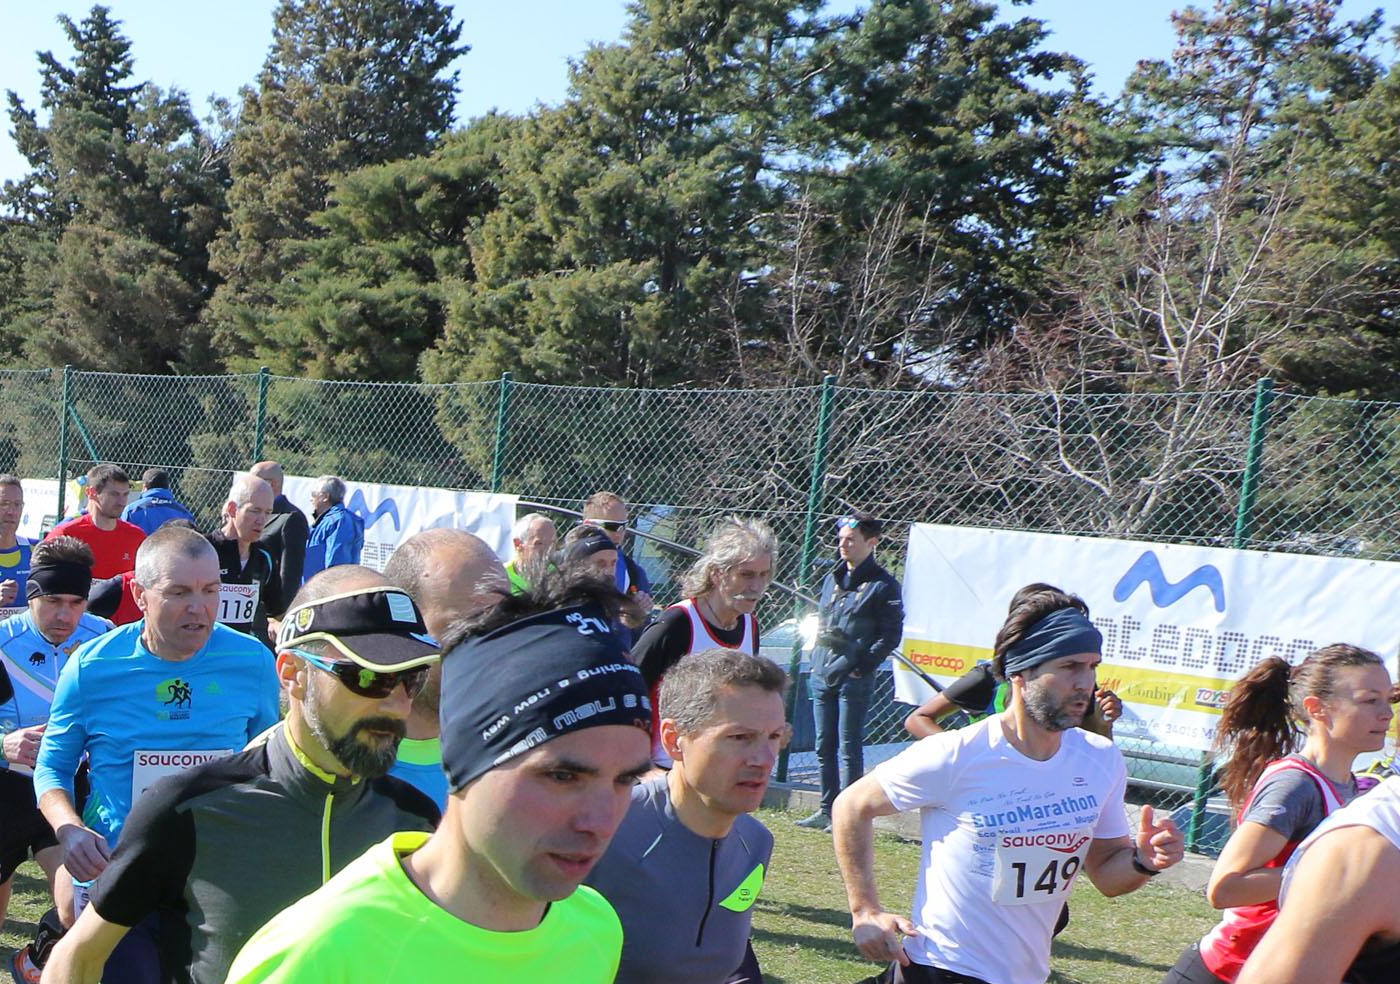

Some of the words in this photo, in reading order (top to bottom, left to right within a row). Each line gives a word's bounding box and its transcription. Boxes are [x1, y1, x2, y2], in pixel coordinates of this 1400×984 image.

[222, 600, 254, 620] 118
[513, 687, 551, 715] new
[482, 714, 511, 741] way
[971, 795, 1098, 828] EuroMarathon
[1002, 832, 1077, 848] saucony
[1011, 855, 1080, 898] 149
